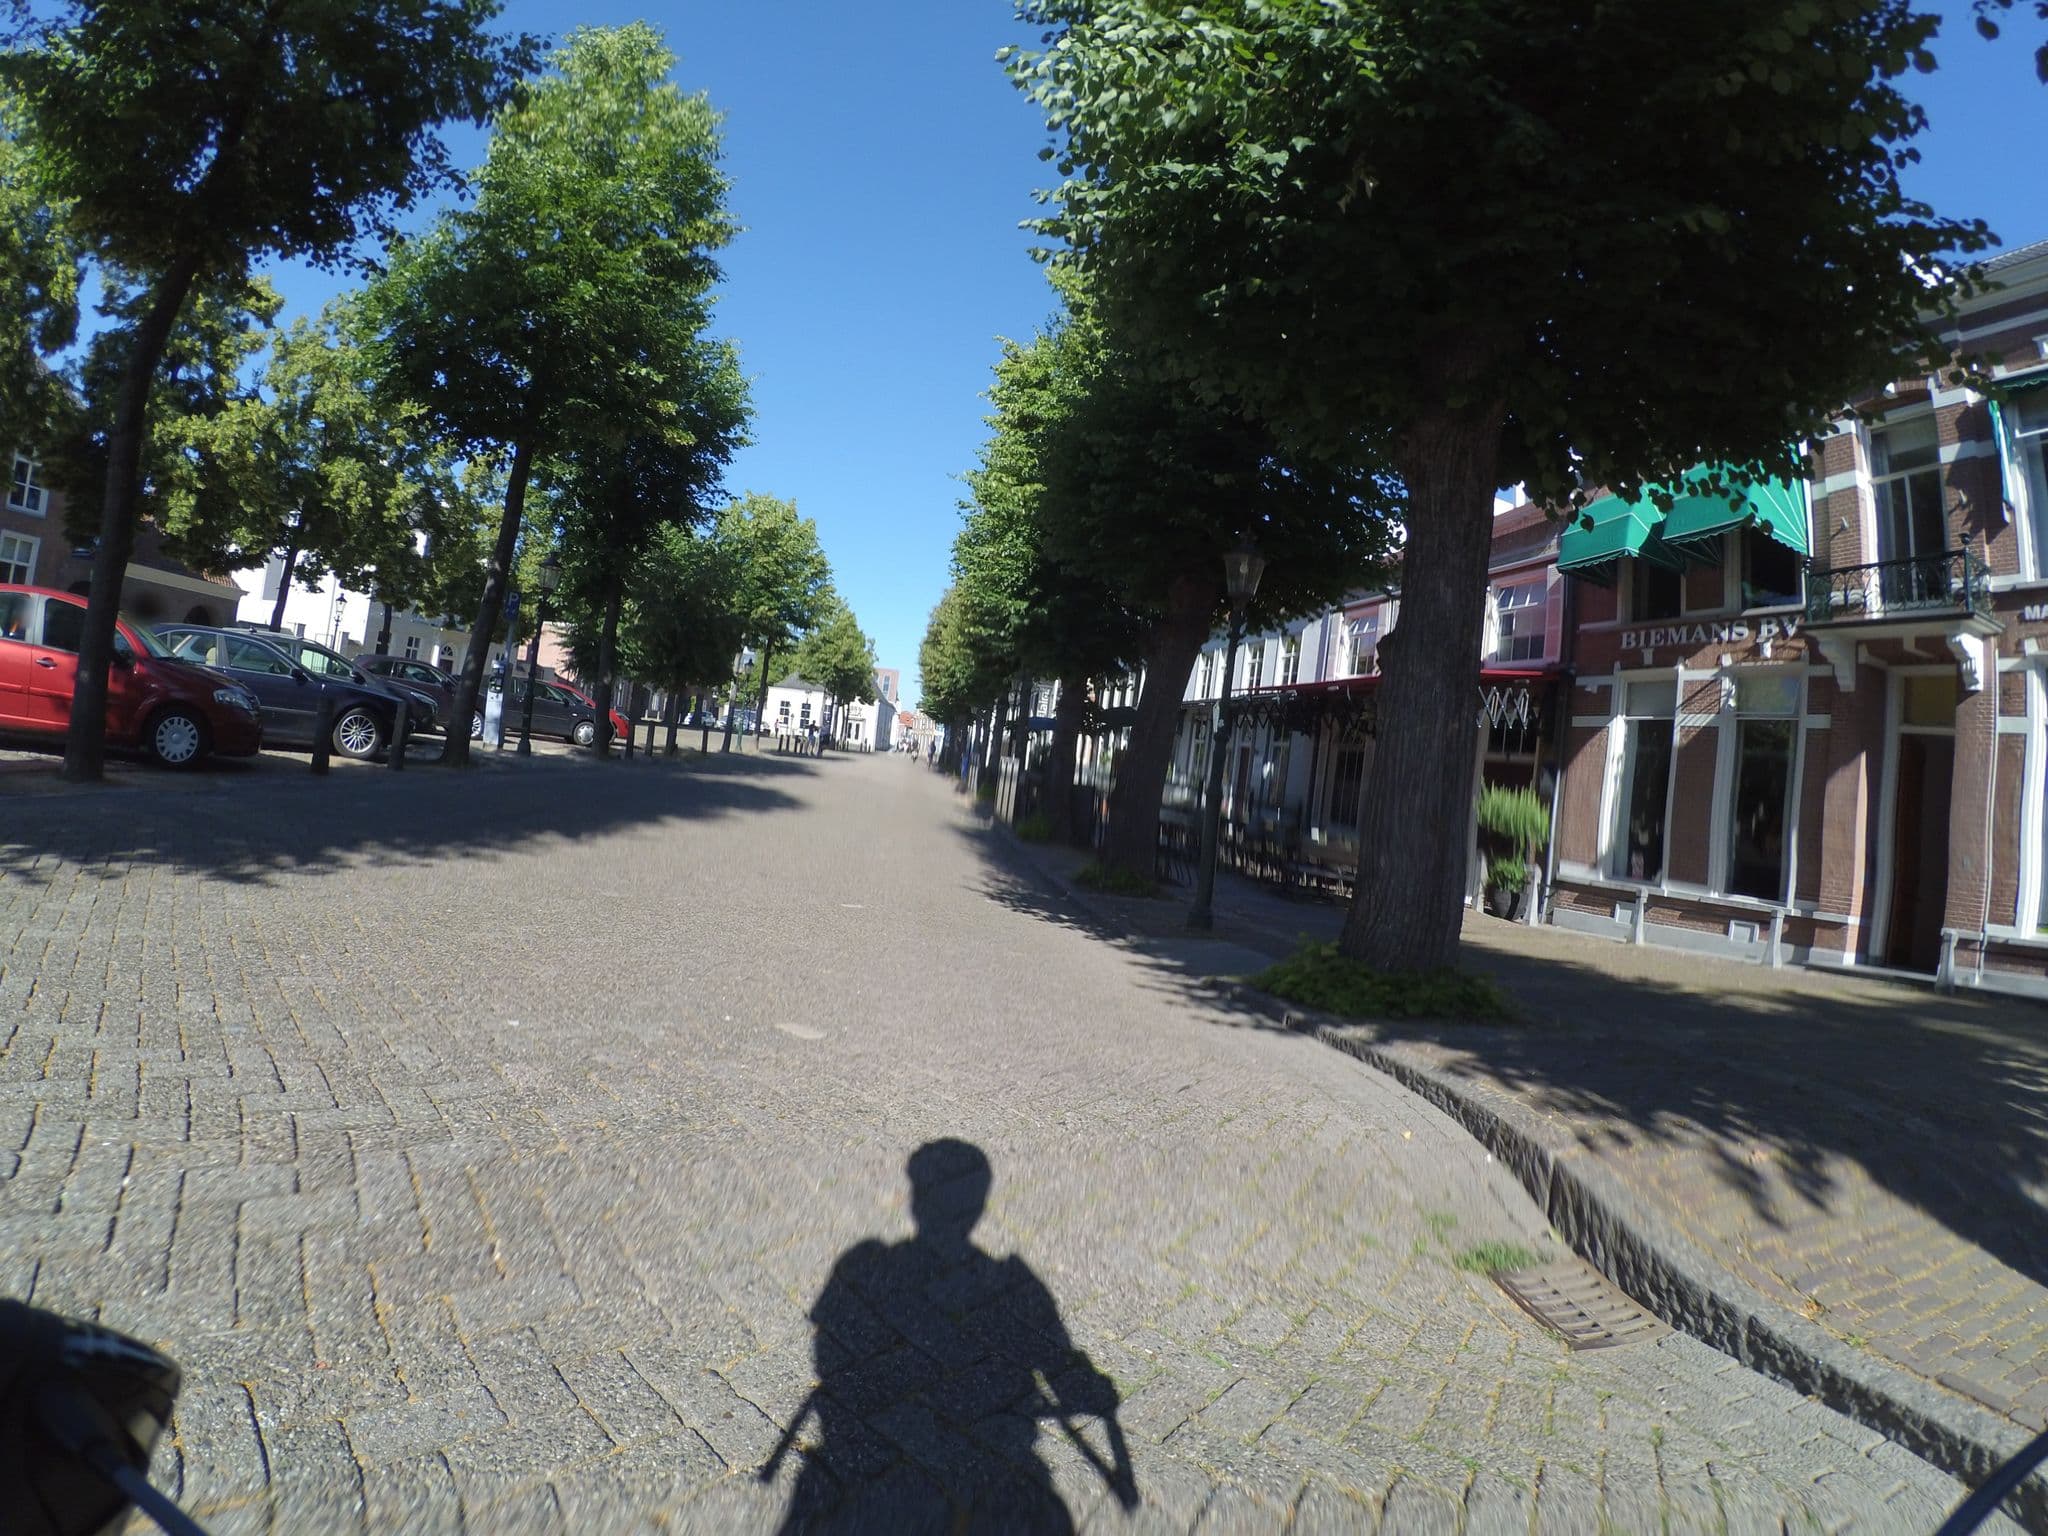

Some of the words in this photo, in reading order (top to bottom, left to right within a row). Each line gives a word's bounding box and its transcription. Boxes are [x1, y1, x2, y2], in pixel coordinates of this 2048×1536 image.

[509, 592, 519, 605] P
[1621, 620, 1749, 648] BIEMANS
[1757, 615, 1801, 642] BV
